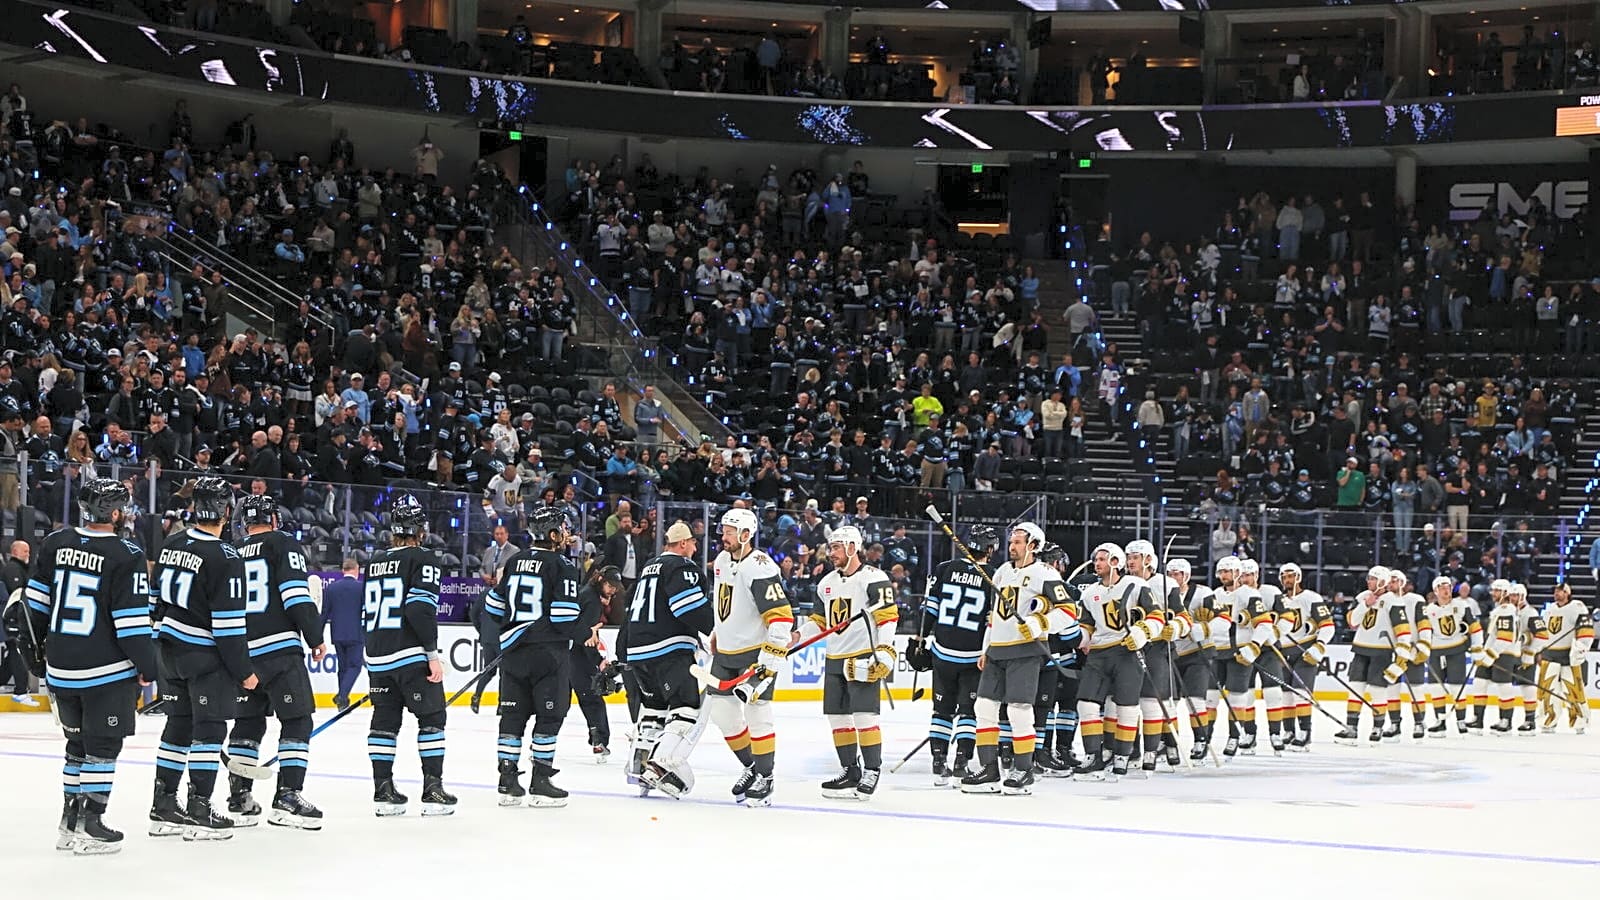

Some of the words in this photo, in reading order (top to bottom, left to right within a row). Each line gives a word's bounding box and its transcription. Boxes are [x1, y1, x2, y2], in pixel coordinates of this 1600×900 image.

[288, 551, 307, 573] 88
[369, 560, 401, 577] COOLEY
[133, 572, 149, 595] 15
[159, 568, 194, 610] 11
[229, 577, 242, 598] 11
[563, 579, 577, 598] 13
[951, 571, 983, 587] McBAIN
[1022, 575, 1031, 587] C
[51, 569, 101, 636] 15
[507, 574, 543, 622] 13
[630, 577, 658, 622] 41
[765, 583, 785, 602] 48
[877, 587, 894, 604] 19
[365, 577, 404, 632] 92
[938, 583, 986, 631] 22
